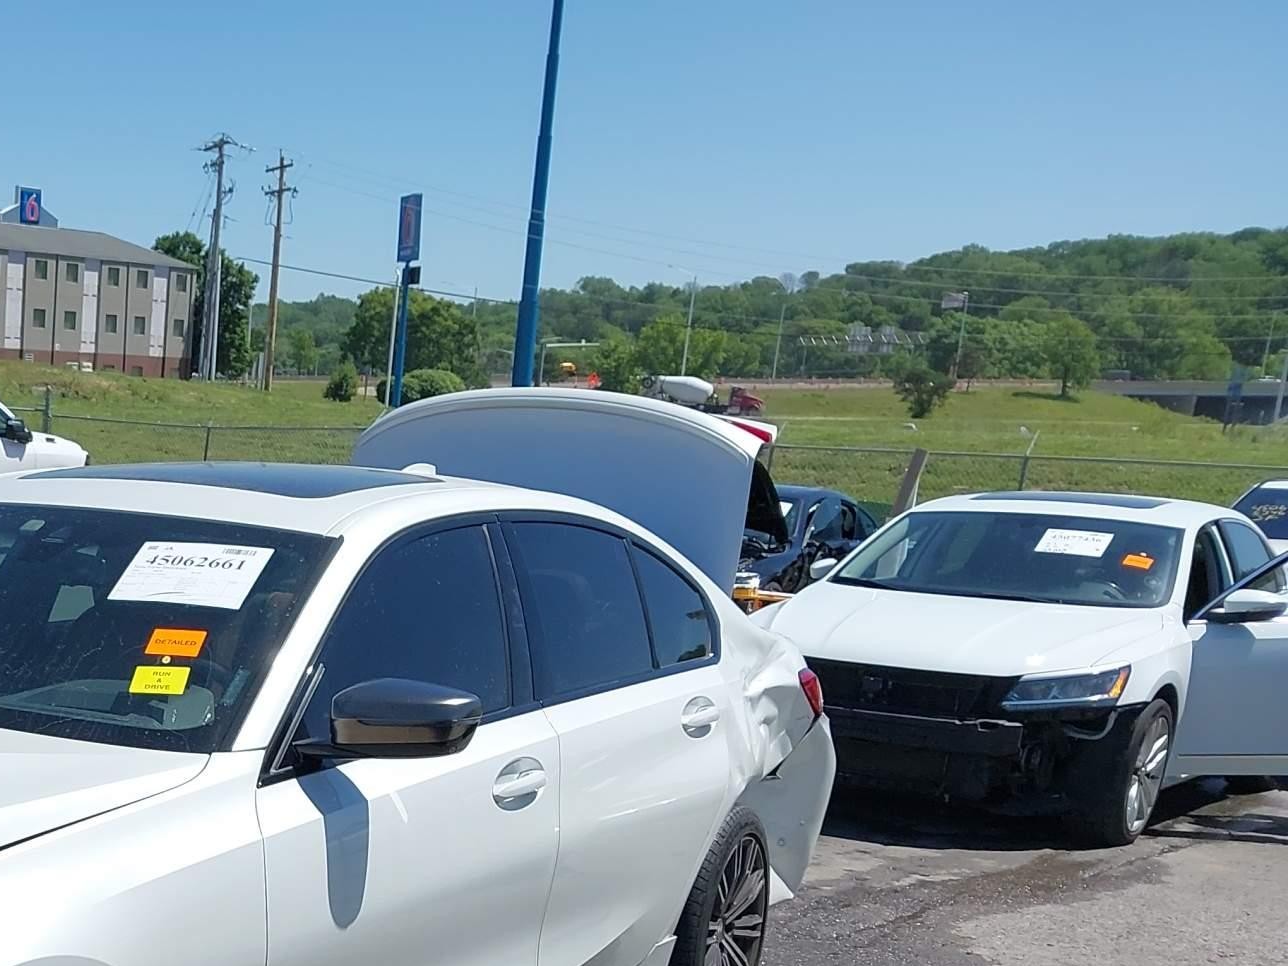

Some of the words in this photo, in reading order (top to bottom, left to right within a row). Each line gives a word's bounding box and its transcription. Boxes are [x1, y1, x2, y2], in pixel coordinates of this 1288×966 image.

[26, 193, 39, 221] 6
[145, 554, 246, 570] 45062661
[155, 638, 197, 646] DETAILED
